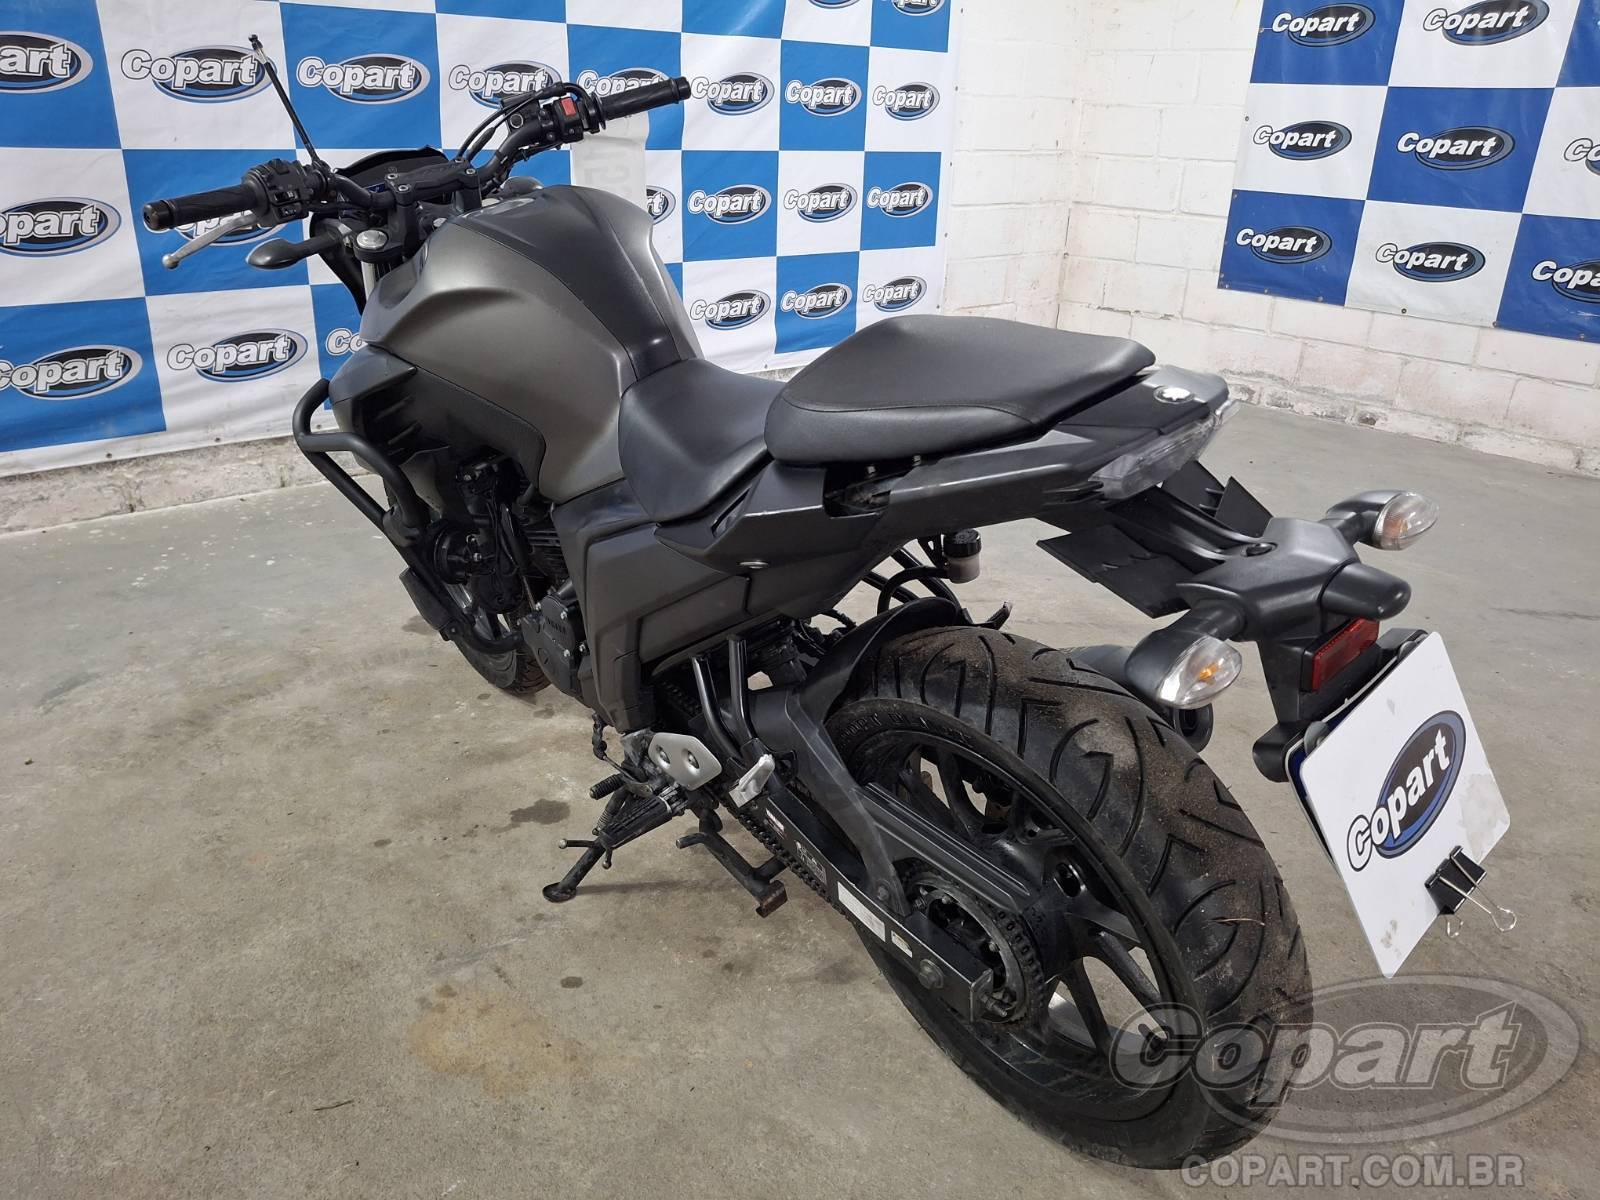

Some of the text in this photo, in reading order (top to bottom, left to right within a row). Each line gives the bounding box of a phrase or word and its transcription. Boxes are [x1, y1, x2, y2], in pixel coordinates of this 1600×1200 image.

[1271, 12, 1360, 37] Copart
[1423, 4, 1530, 37] Copart
[121, 49, 257, 90] Copart
[297, 57, 418, 95] Copart
[449, 65, 548, 98] Copart
[691, 76, 764, 107] Copart
[785, 80, 854, 109] Copart
[872, 86, 932, 112] Copart
[1253, 125, 1338, 150] Copart
[1397, 132, 1497, 159] Copart
[688, 190, 764, 218] Copart
[784, 189, 849, 215] Copart
[867, 187, 926, 211] Copart
[0, 203, 100, 246] part
[1236, 228, 1318, 253] Copart
[1375, 243, 1469, 272] Copart
[781, 286, 845, 313] Copart
[862, 280, 920, 304] Copart
[690, 296, 763, 323] Copart
[167, 334, 291, 373] Copart
[1346, 729, 1451, 872] Copart
